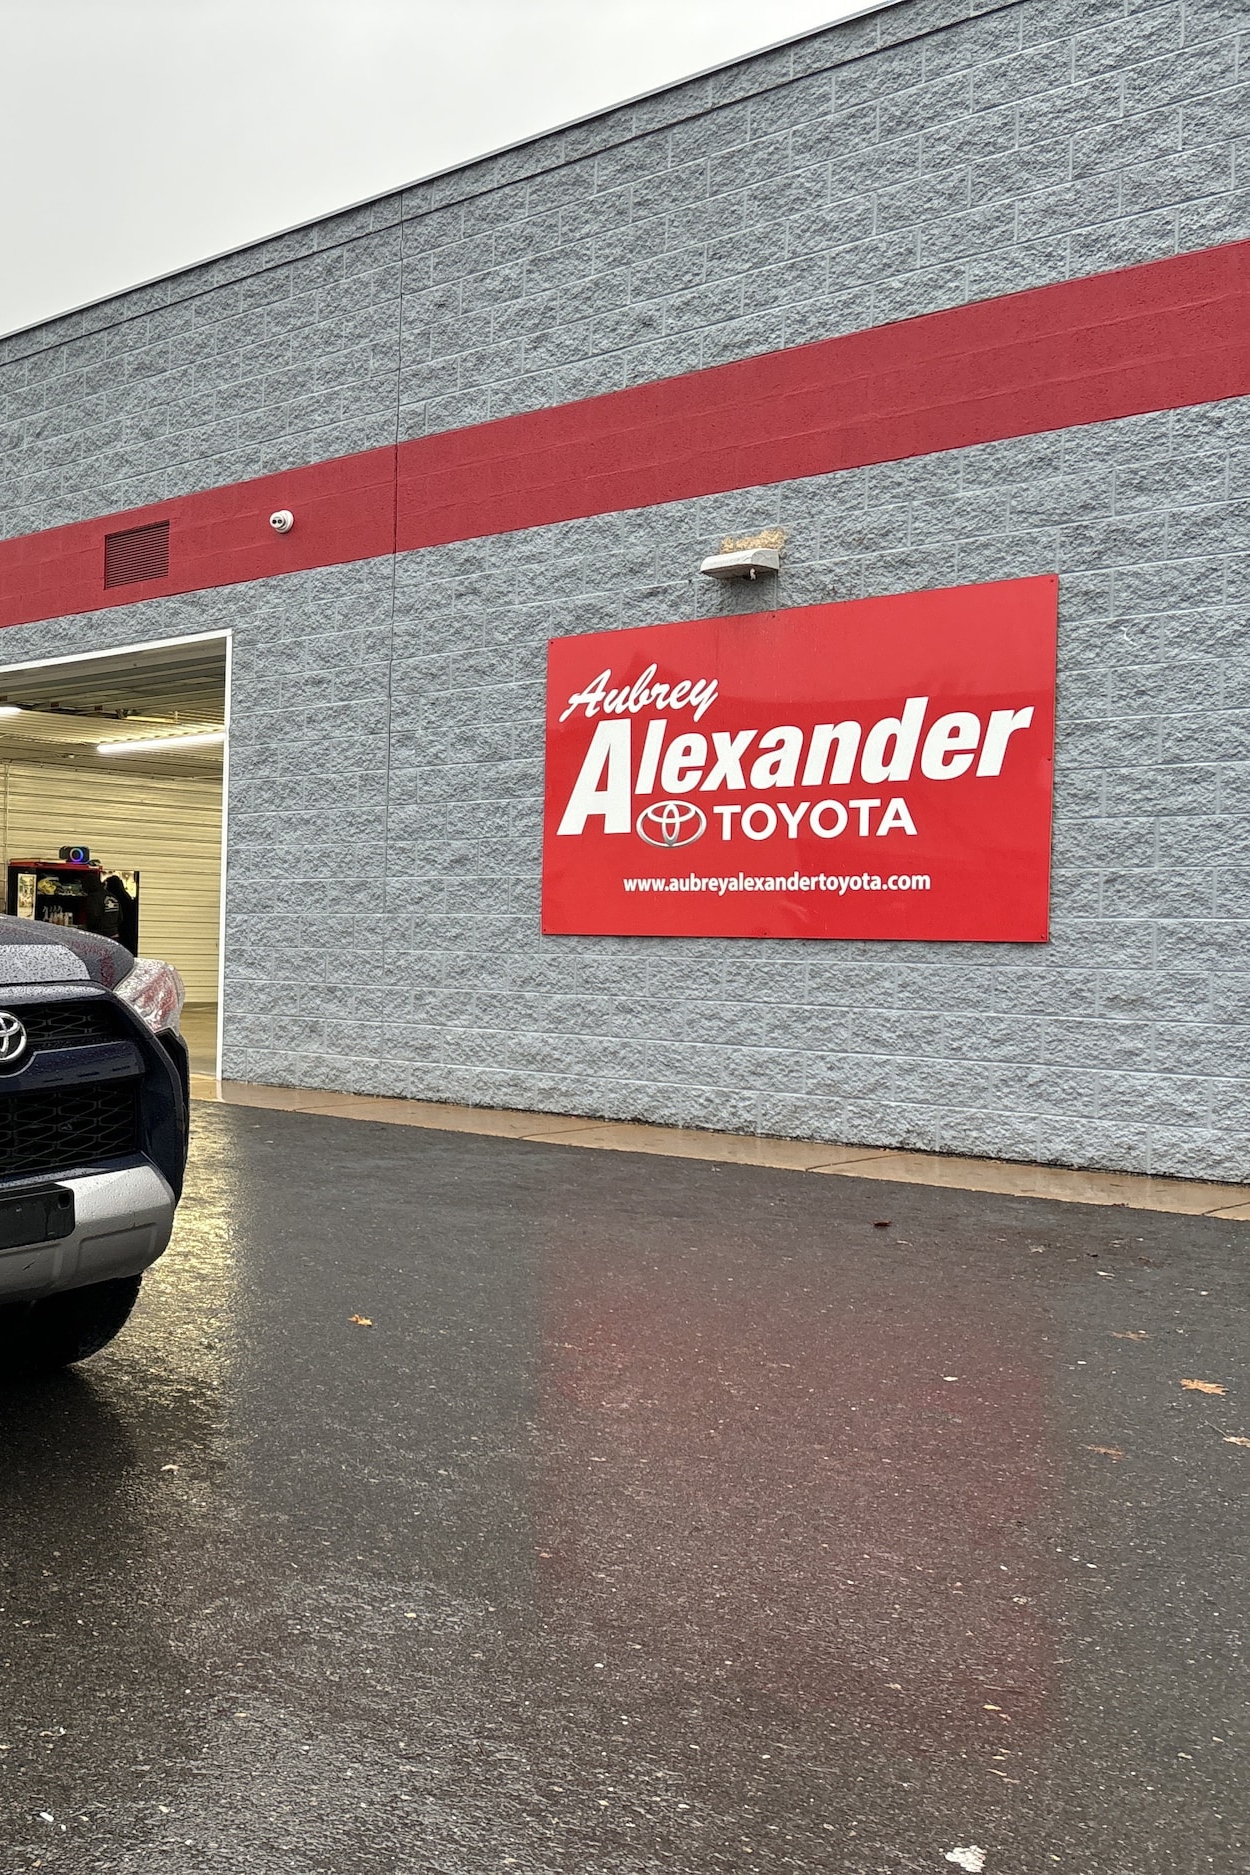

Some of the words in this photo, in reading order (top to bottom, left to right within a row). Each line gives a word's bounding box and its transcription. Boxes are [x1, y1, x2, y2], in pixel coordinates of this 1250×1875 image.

[558, 663, 719, 722] Aubrey
[556, 696, 1035, 836] Alexander
[713, 797, 918, 841] TOYOTA
[623, 871, 931, 897] www.aubreyalexandertoyota.com
